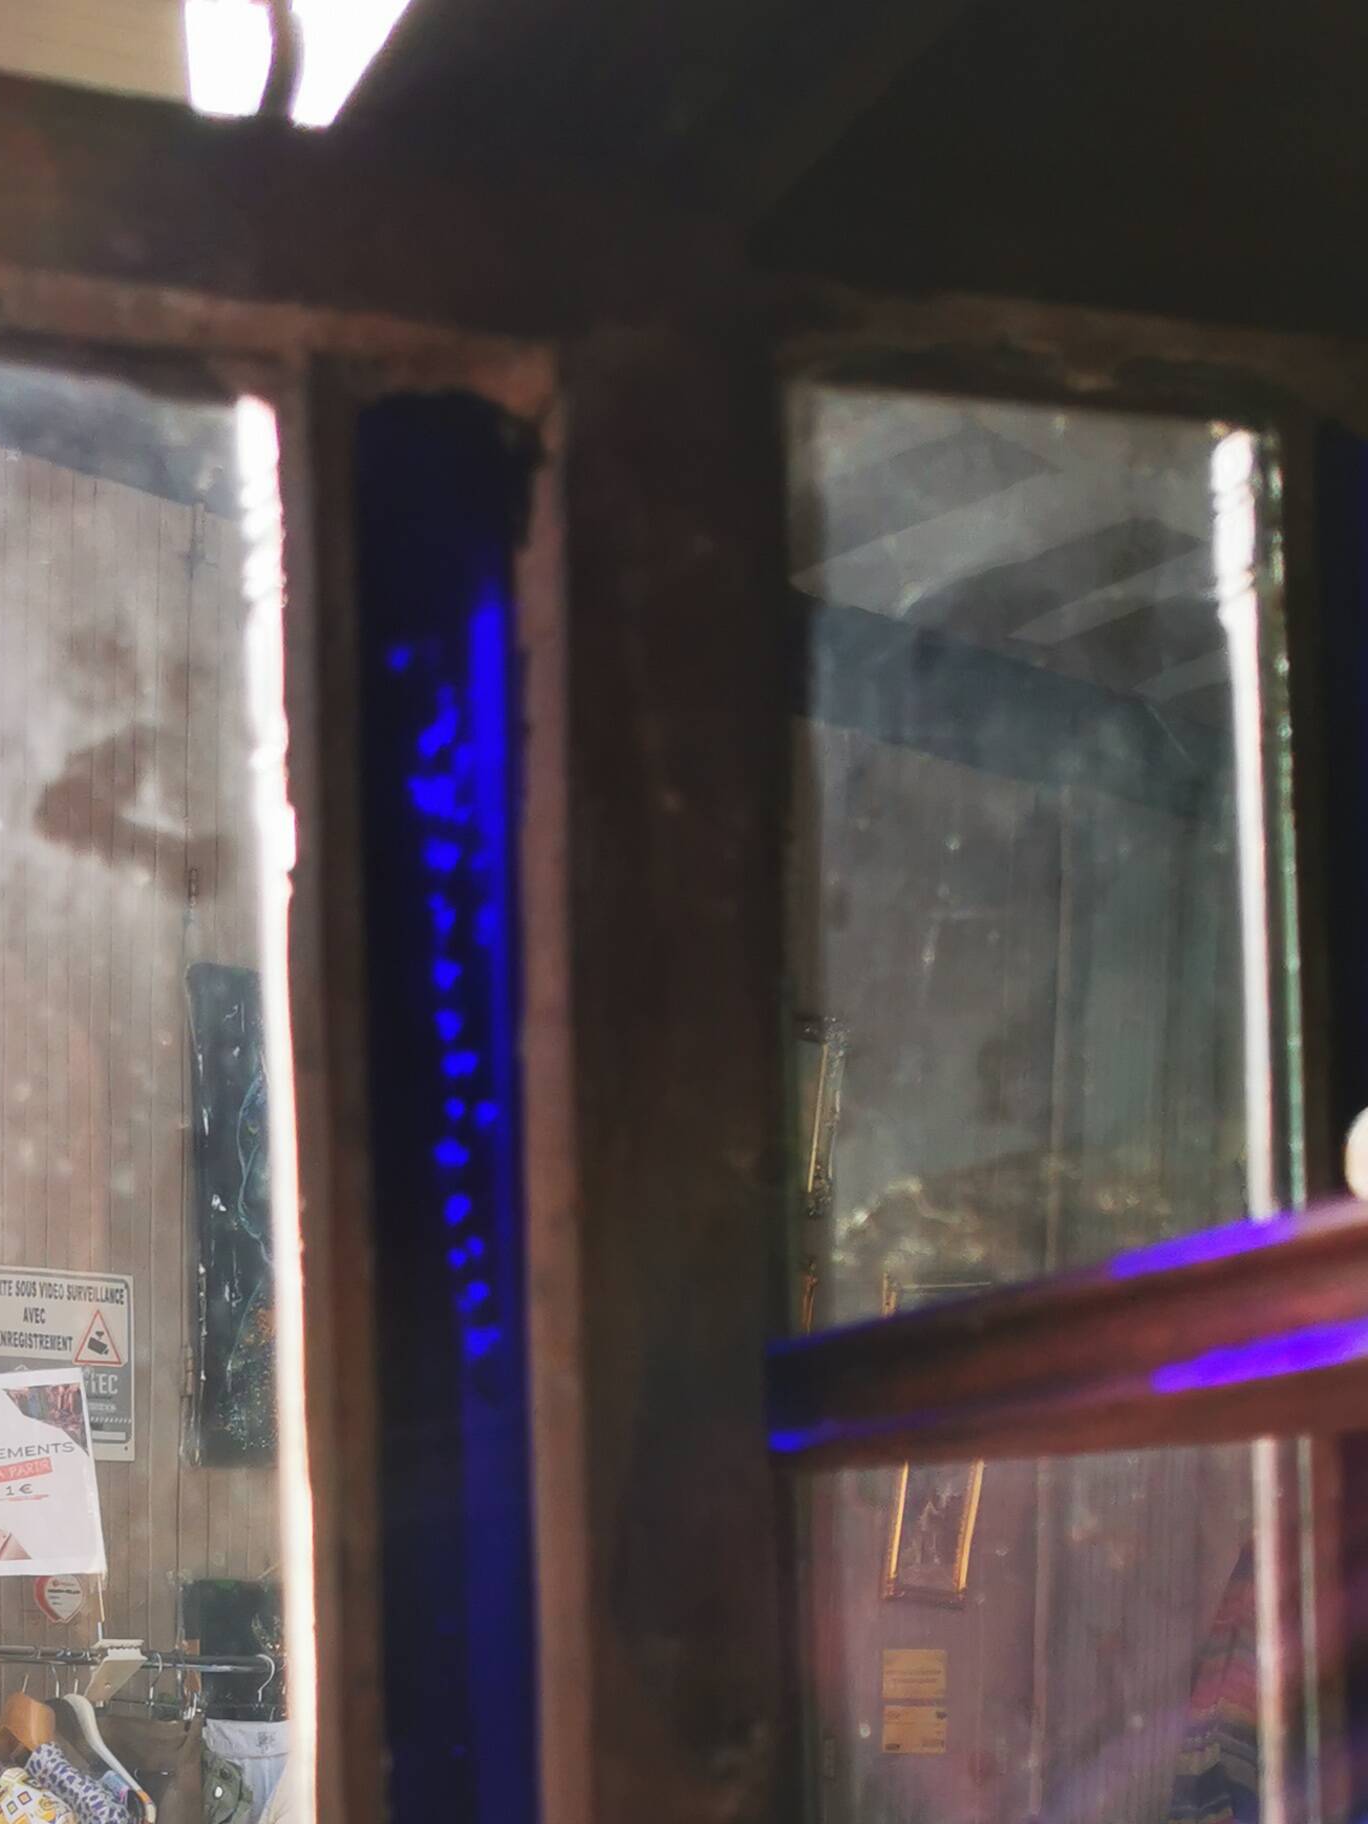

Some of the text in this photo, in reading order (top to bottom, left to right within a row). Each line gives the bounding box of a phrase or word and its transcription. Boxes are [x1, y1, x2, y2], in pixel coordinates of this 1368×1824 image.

[15, 1279, 37, 1298] SOUS
[39, 1281, 64, 1300] VIDEO
[67, 1284, 124, 1305] SURVEILLANCE
[23, 1306, 46, 1324] AVEC
[5, 1483, 33, 1496] 1 €
